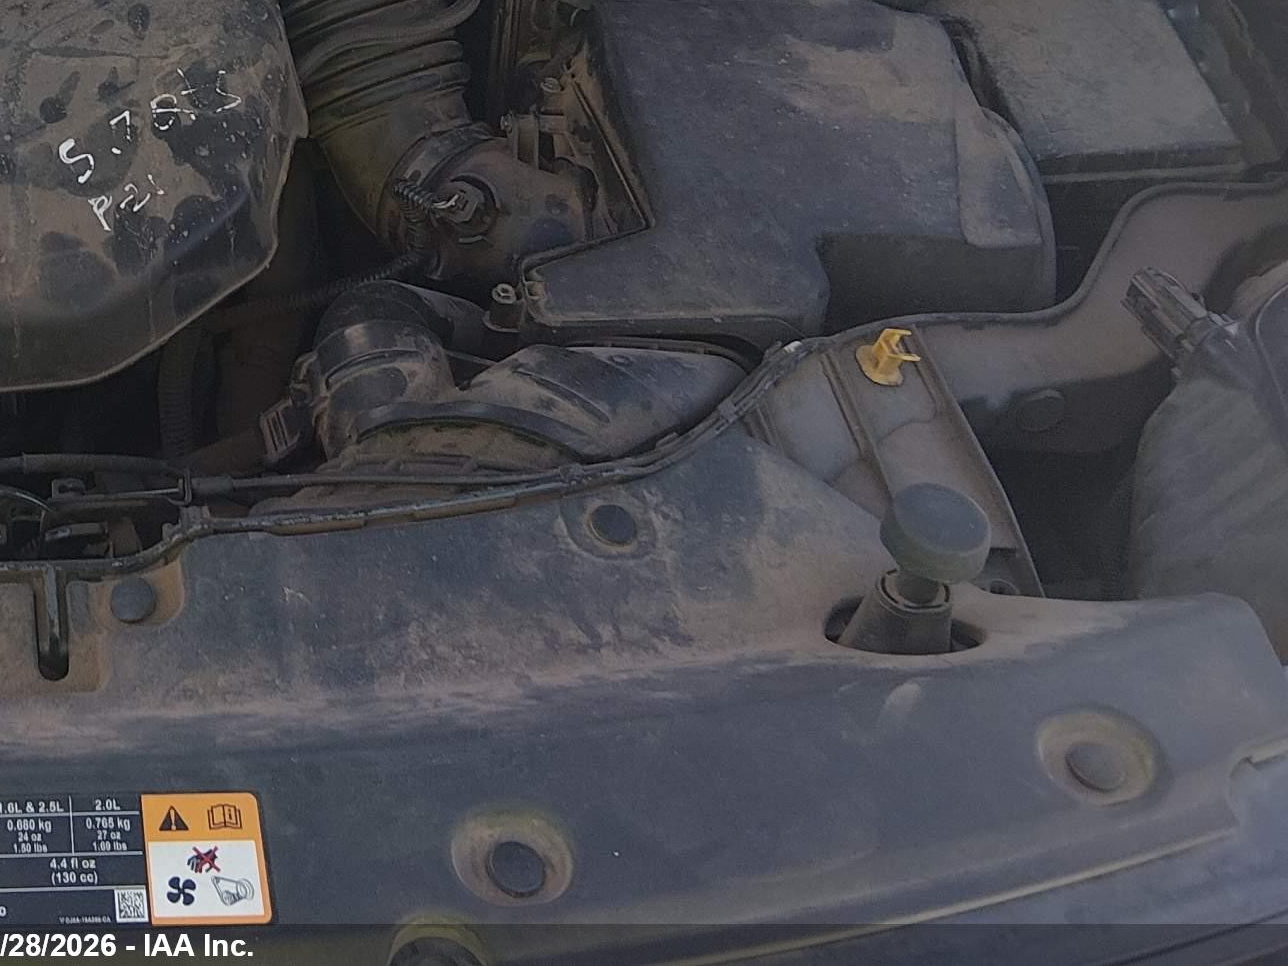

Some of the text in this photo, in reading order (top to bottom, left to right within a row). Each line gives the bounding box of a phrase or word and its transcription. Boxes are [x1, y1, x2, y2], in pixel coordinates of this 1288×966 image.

[25, 801, 35, 813] &
[38, 801, 64, 813] 2.5L
[94, 799, 121, 811] 2.0L
[38, 818, 52, 832] kg
[85, 817, 131, 831] 0.765 kg
[17, 832, 42, 842] 24 oz
[97, 831, 121, 841] 27 oz
[33, 843, 48, 853] lbs
[113, 841, 128, 851] lbs
[49, 858, 97, 869] 4.4 fl oz
[51, 871, 98, 885] (130 cc)
